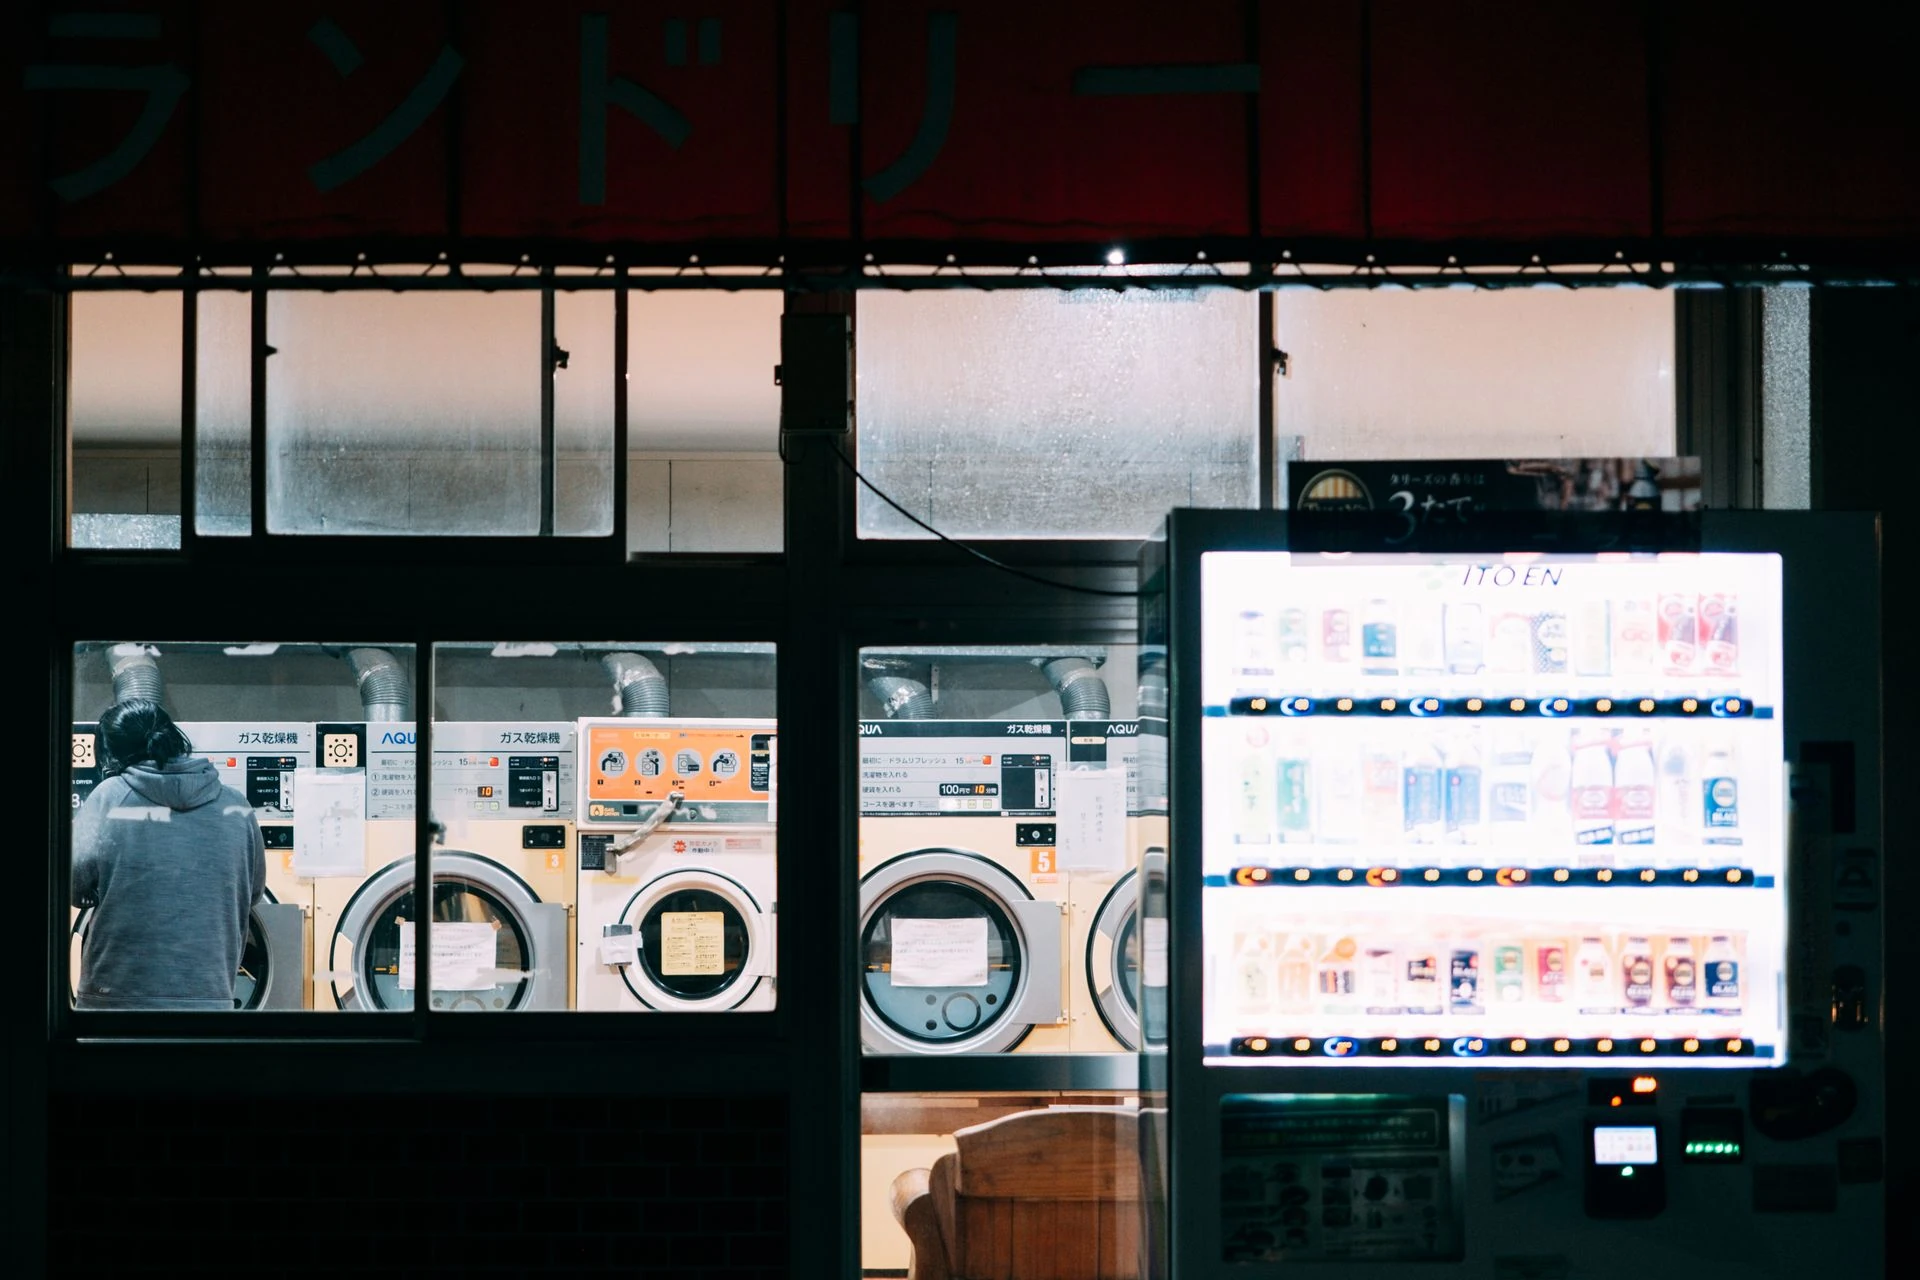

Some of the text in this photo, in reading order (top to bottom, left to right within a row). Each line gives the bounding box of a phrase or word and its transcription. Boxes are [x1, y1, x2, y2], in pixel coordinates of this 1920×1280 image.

[24, 12, 1260, 204] ランドリー
[1462, 564, 1563, 587] ITO EN
[859, 724, 882, 735] QUA
[1007, 724, 1052, 734] ガス乾燥機
[238, 732, 298, 745] ガス乾燥機
[381, 731, 416, 745] AQU
[500, 732, 561, 744] ガス乾燥機
[481, 787, 492, 796] 10
[1037, 851, 1050, 873] 5
